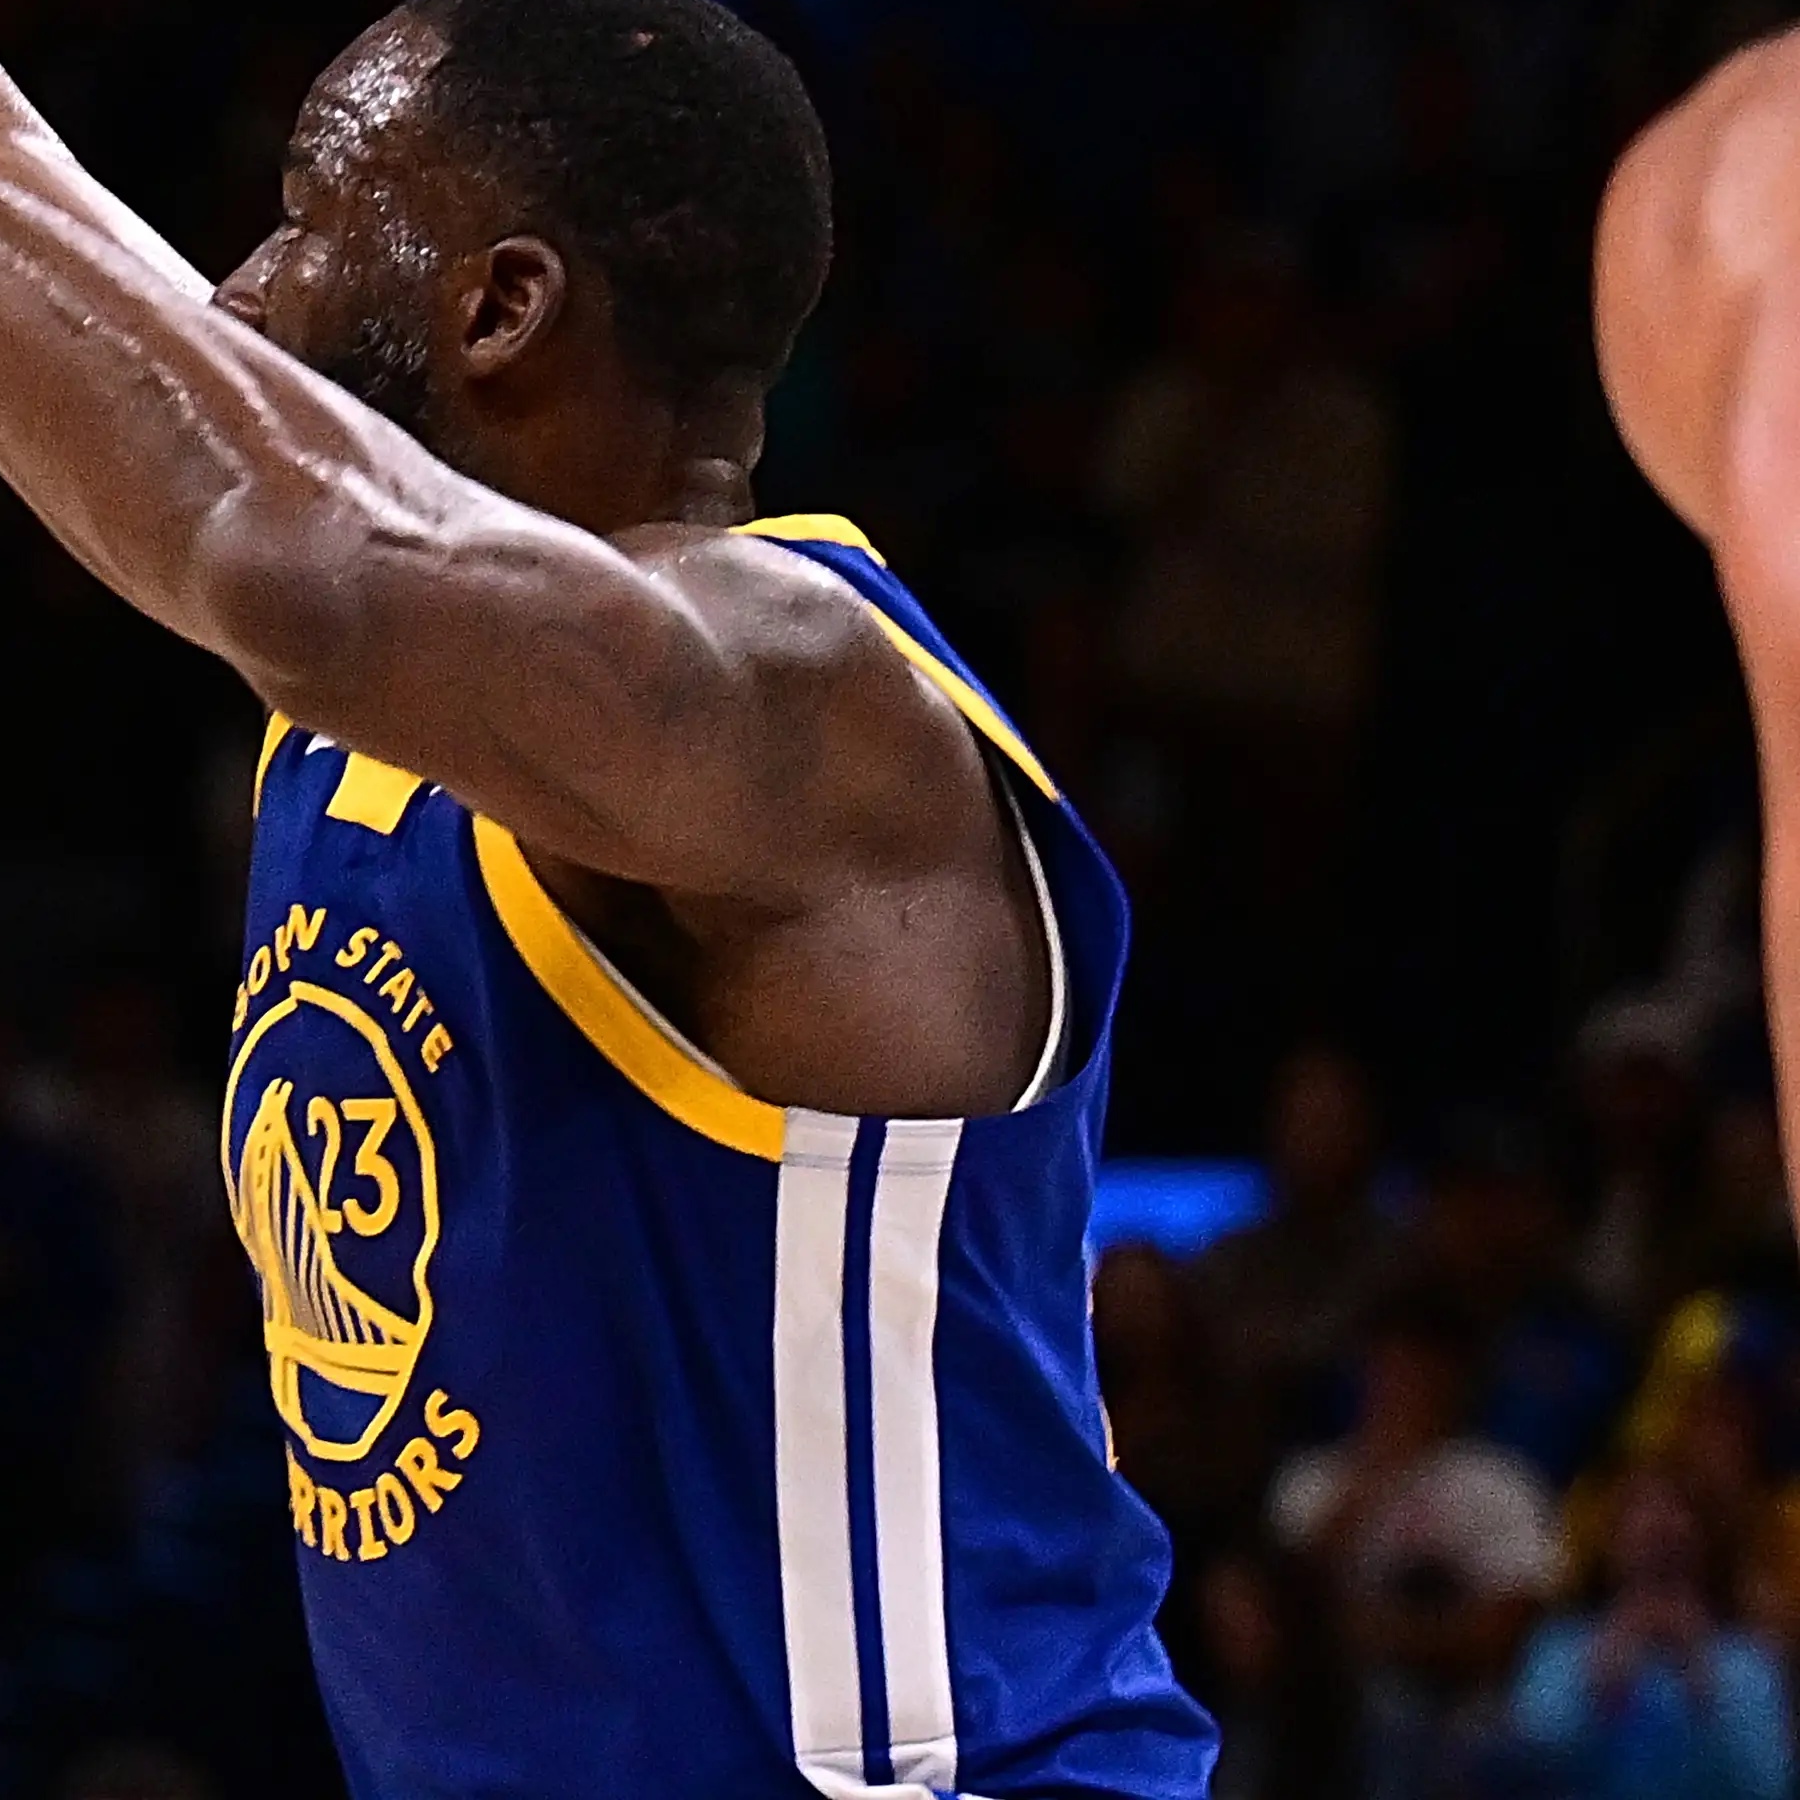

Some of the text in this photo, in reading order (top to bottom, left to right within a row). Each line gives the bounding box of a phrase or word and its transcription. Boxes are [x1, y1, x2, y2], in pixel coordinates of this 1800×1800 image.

[335, 926, 454, 1074] STATE
[306, 1096, 401, 1237] 23
[285, 1388, 481, 1562] RRIORS
